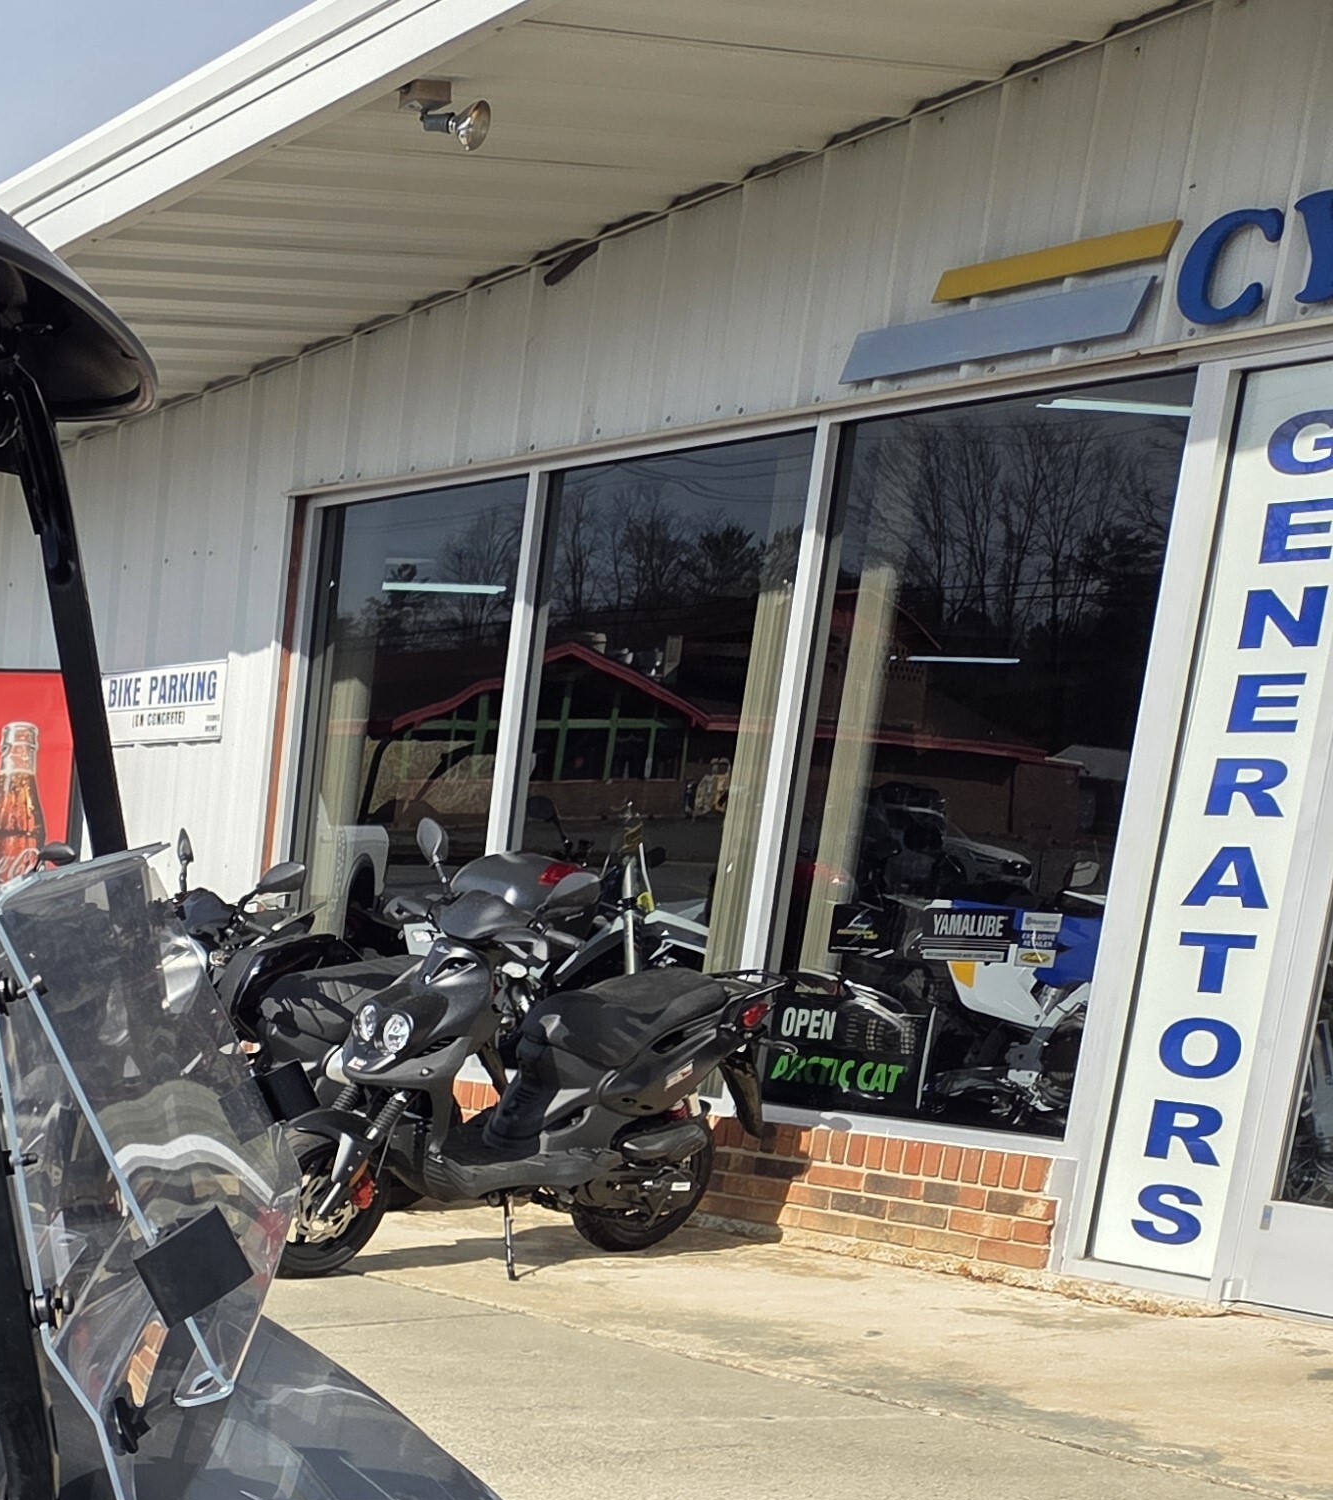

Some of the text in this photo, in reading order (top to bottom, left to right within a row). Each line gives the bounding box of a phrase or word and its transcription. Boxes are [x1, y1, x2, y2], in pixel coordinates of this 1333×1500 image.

[108, 670, 217, 708] BIKE PARKING
[1130, 408, 1333, 1246] GENERATORS
[933, 914, 1005, 937] YAMALUBE
[781, 1006, 837, 1041] OPEN
[856, 1060, 906, 1093] CAT
